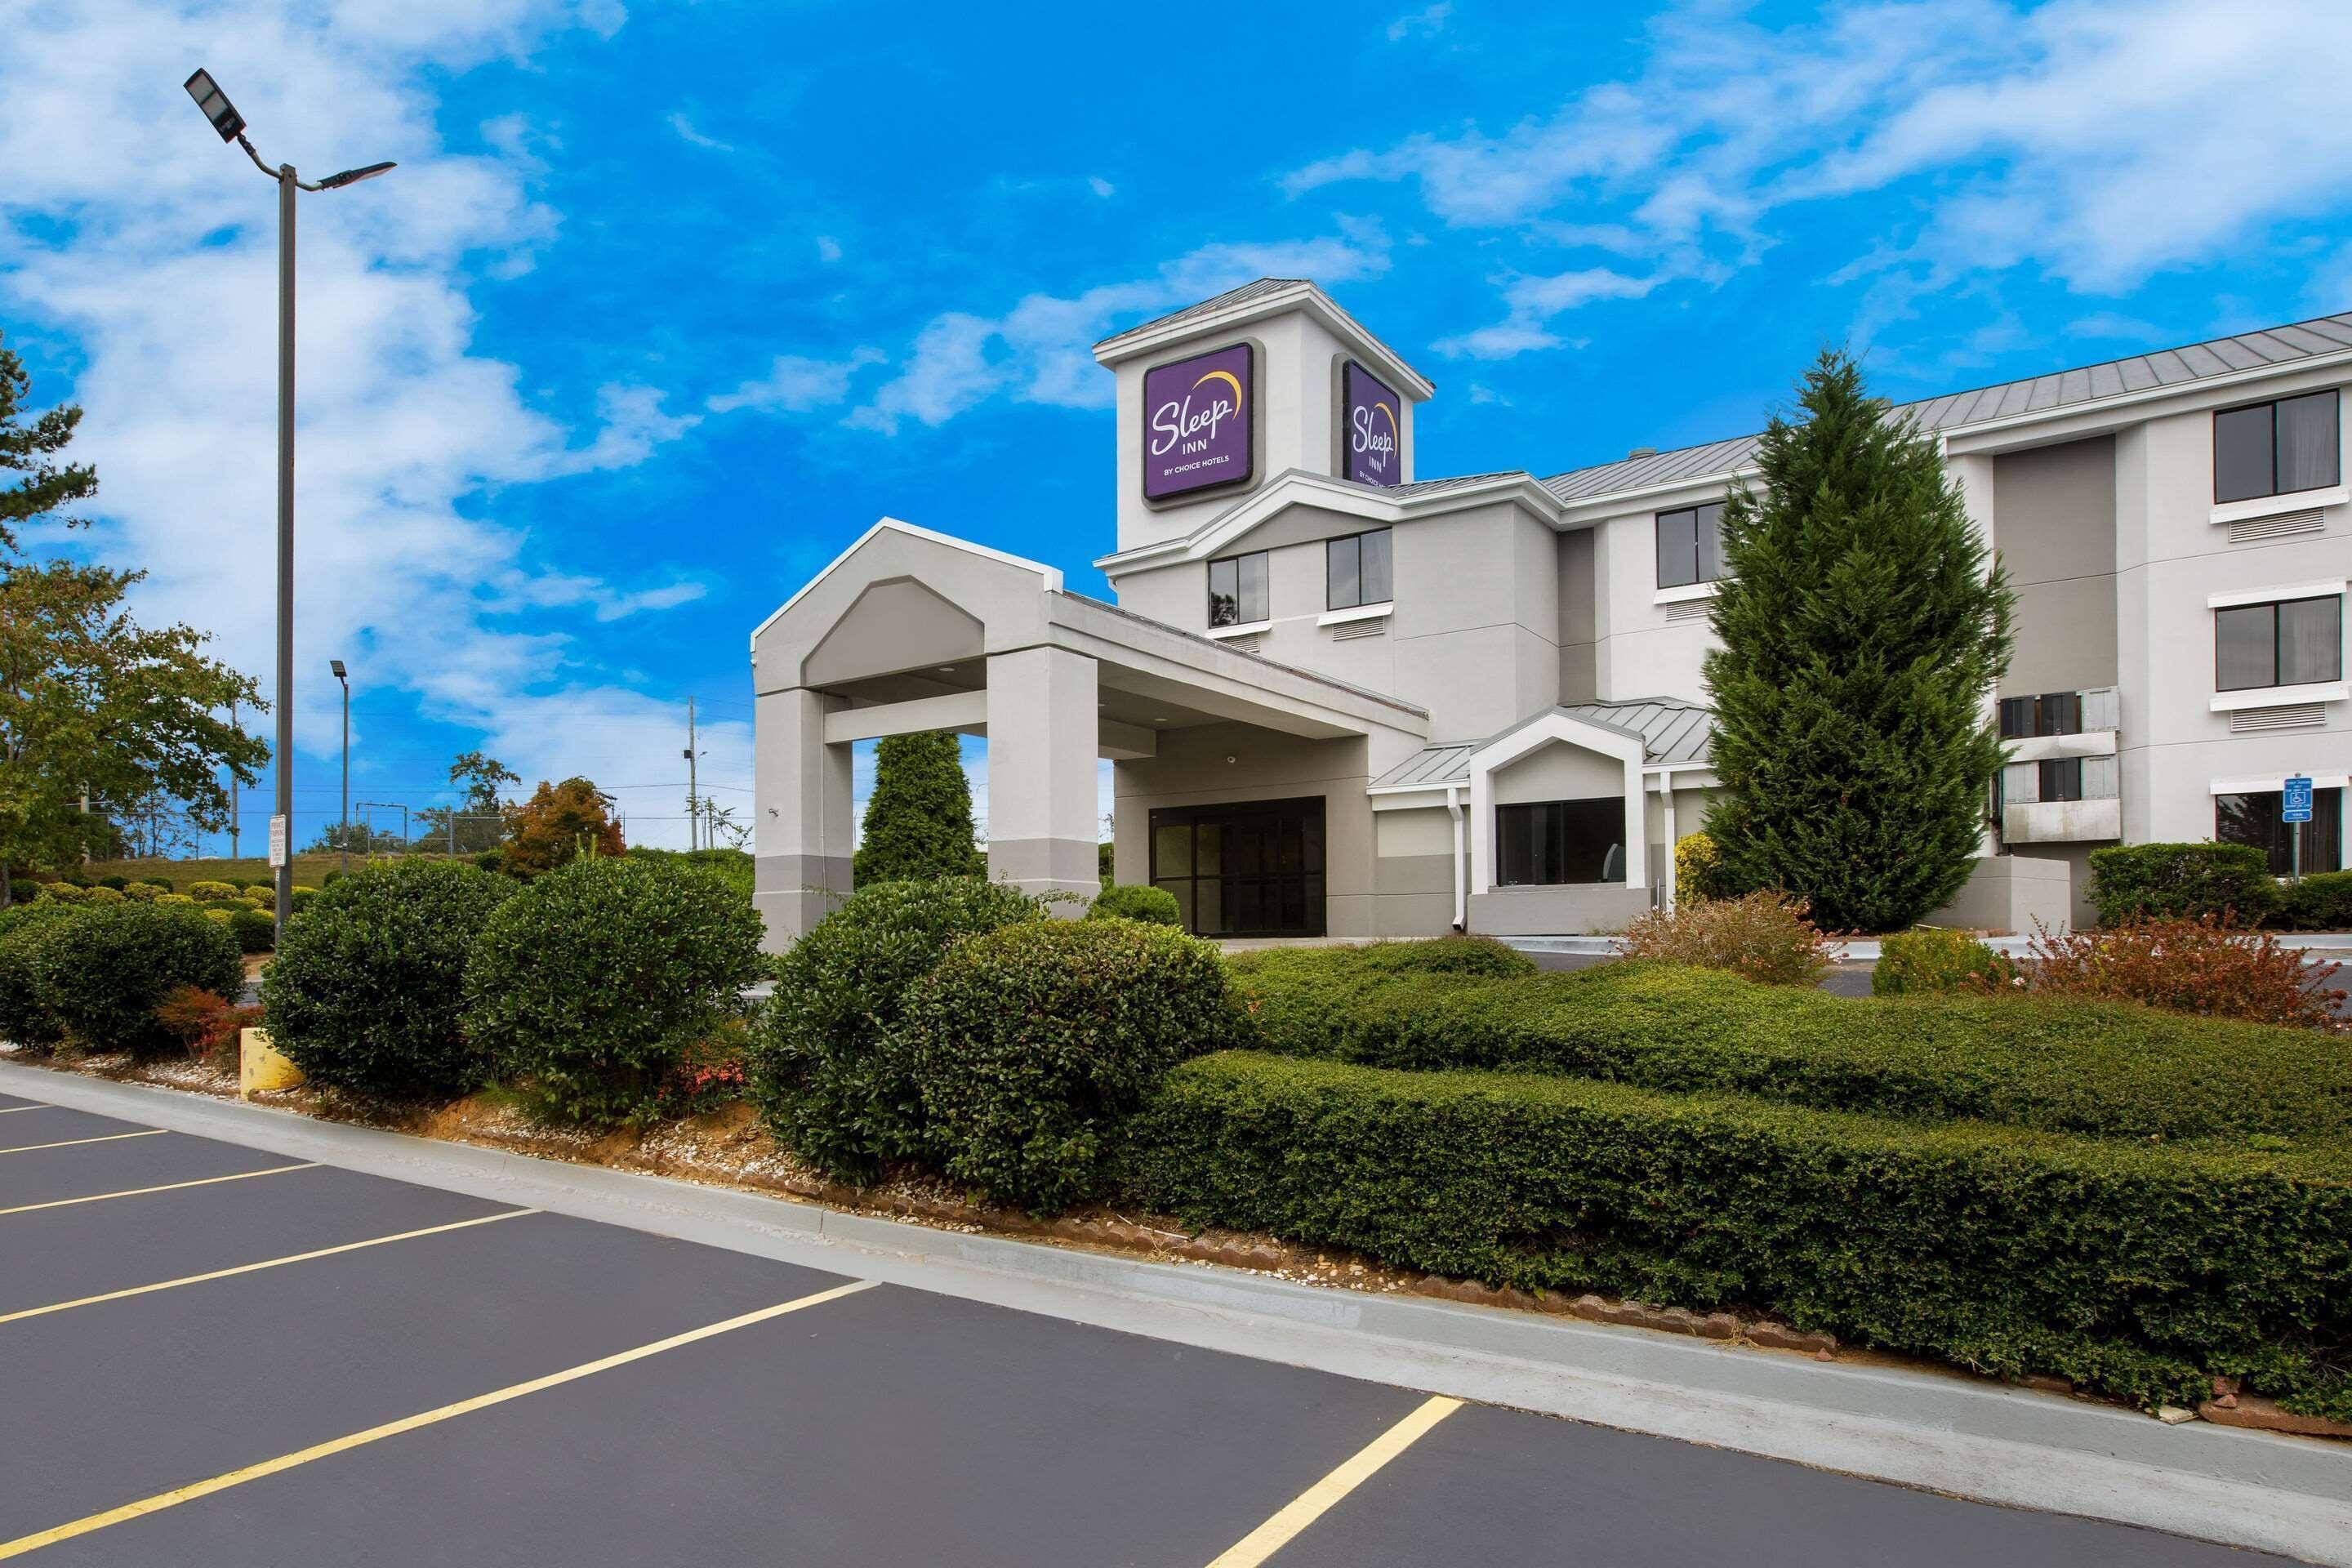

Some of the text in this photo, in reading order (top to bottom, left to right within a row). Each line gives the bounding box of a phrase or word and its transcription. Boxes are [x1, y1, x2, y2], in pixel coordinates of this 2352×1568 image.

[1152, 394, 1233, 456] Sleep
[1183, 438, 1208, 455] INN
[1352, 405, 1394, 468] Sleep
[1164, 455, 1230, 476] BY CHOICE HOTELS
[1369, 456, 1382, 474] INN
